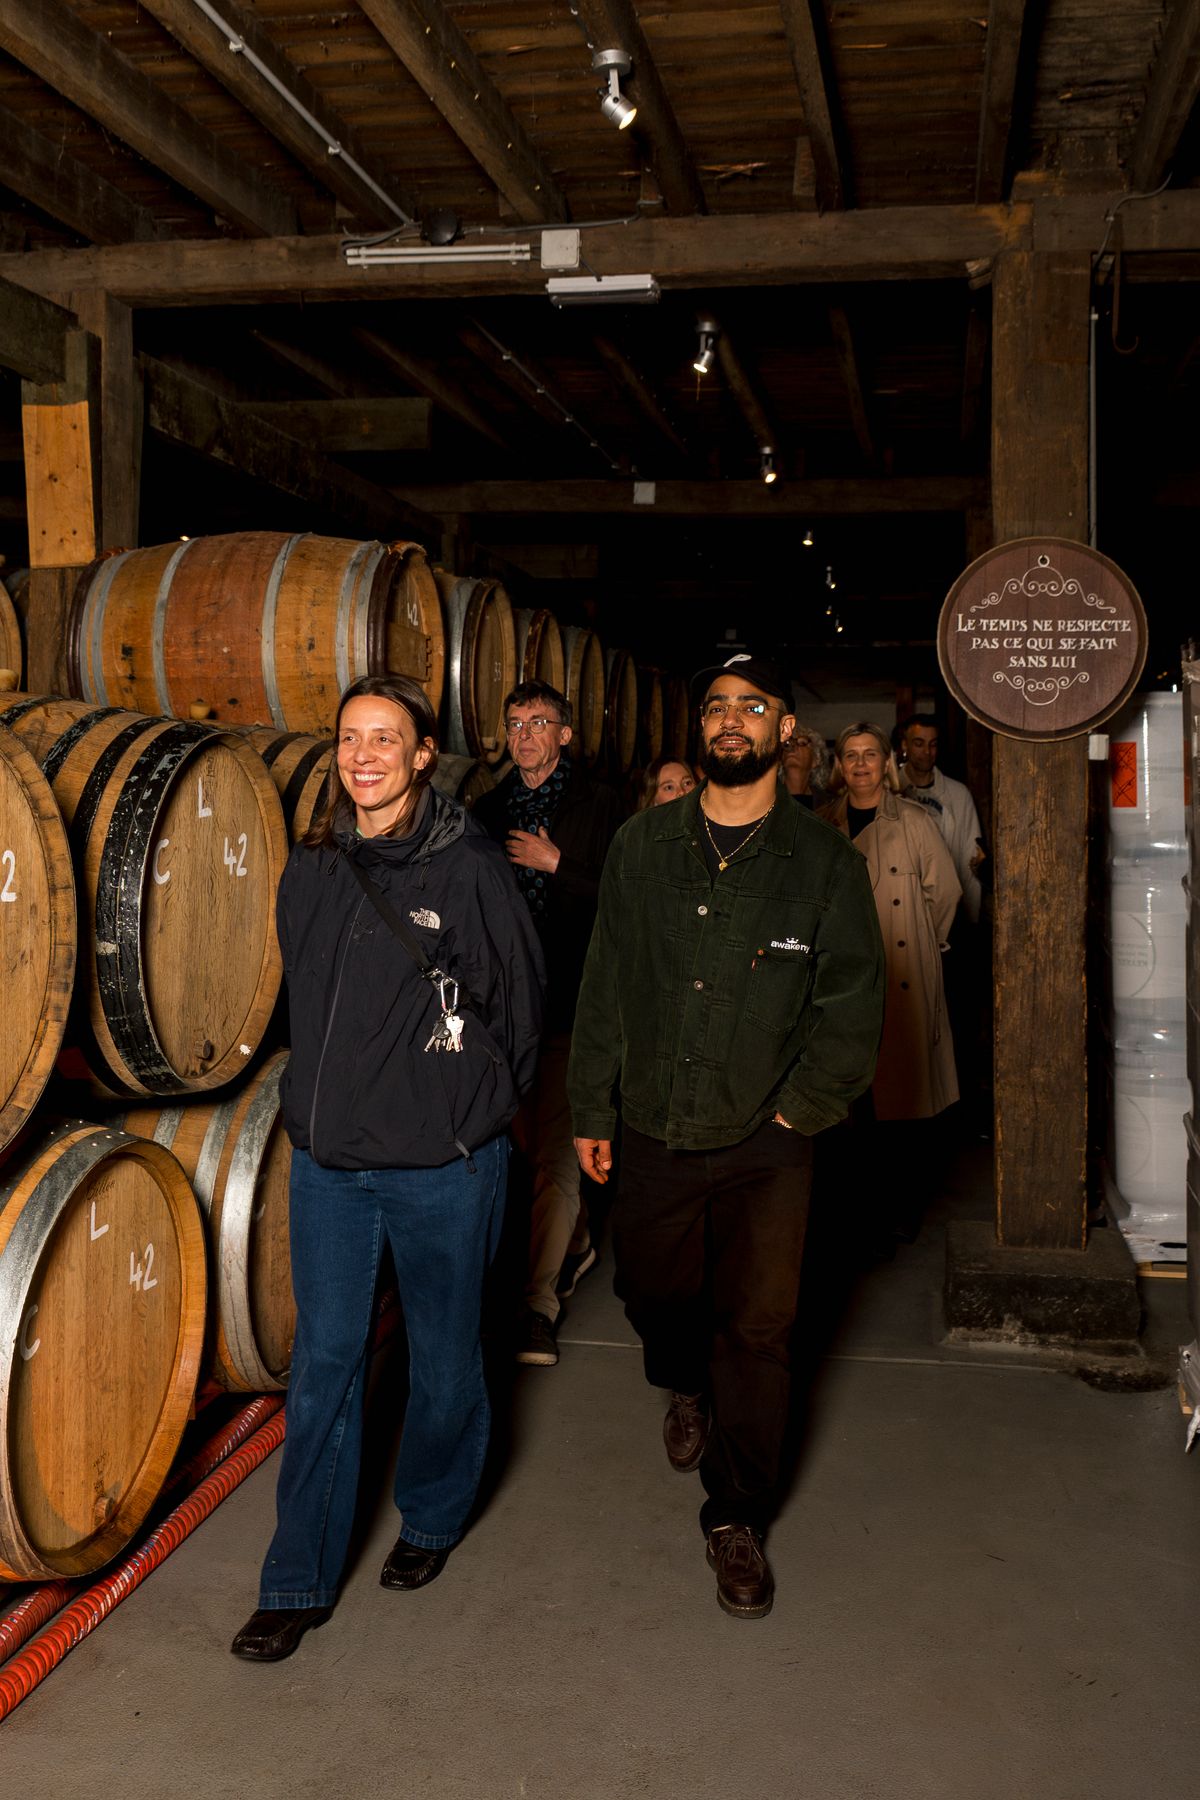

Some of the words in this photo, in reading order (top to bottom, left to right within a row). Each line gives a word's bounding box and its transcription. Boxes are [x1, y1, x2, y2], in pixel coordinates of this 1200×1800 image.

[407, 602, 419, 626] 42
[978, 619, 1028, 632] TEMPS
[1032, 619, 1053, 632] NE
[1057, 619, 1132, 632] RESPECTE
[969, 637, 999, 650] PAS
[1003, 637, 1022, 650] CE
[1026, 637, 1053, 652] QUI
[1059, 637, 1077, 650] SE
[1078, 637, 1118, 650] FAIT
[1007, 655, 1048, 668] SANS
[1051, 655, 1077, 668] LUI
[198, 776, 212, 818] L
[0, 849, 18, 902] 2
[152, 838, 171, 885] C
[223, 832, 248, 877] 42
[90, 1201, 110, 1241] L
[129, 1243, 158, 1292] 42
[19, 1304, 41, 1361] C
